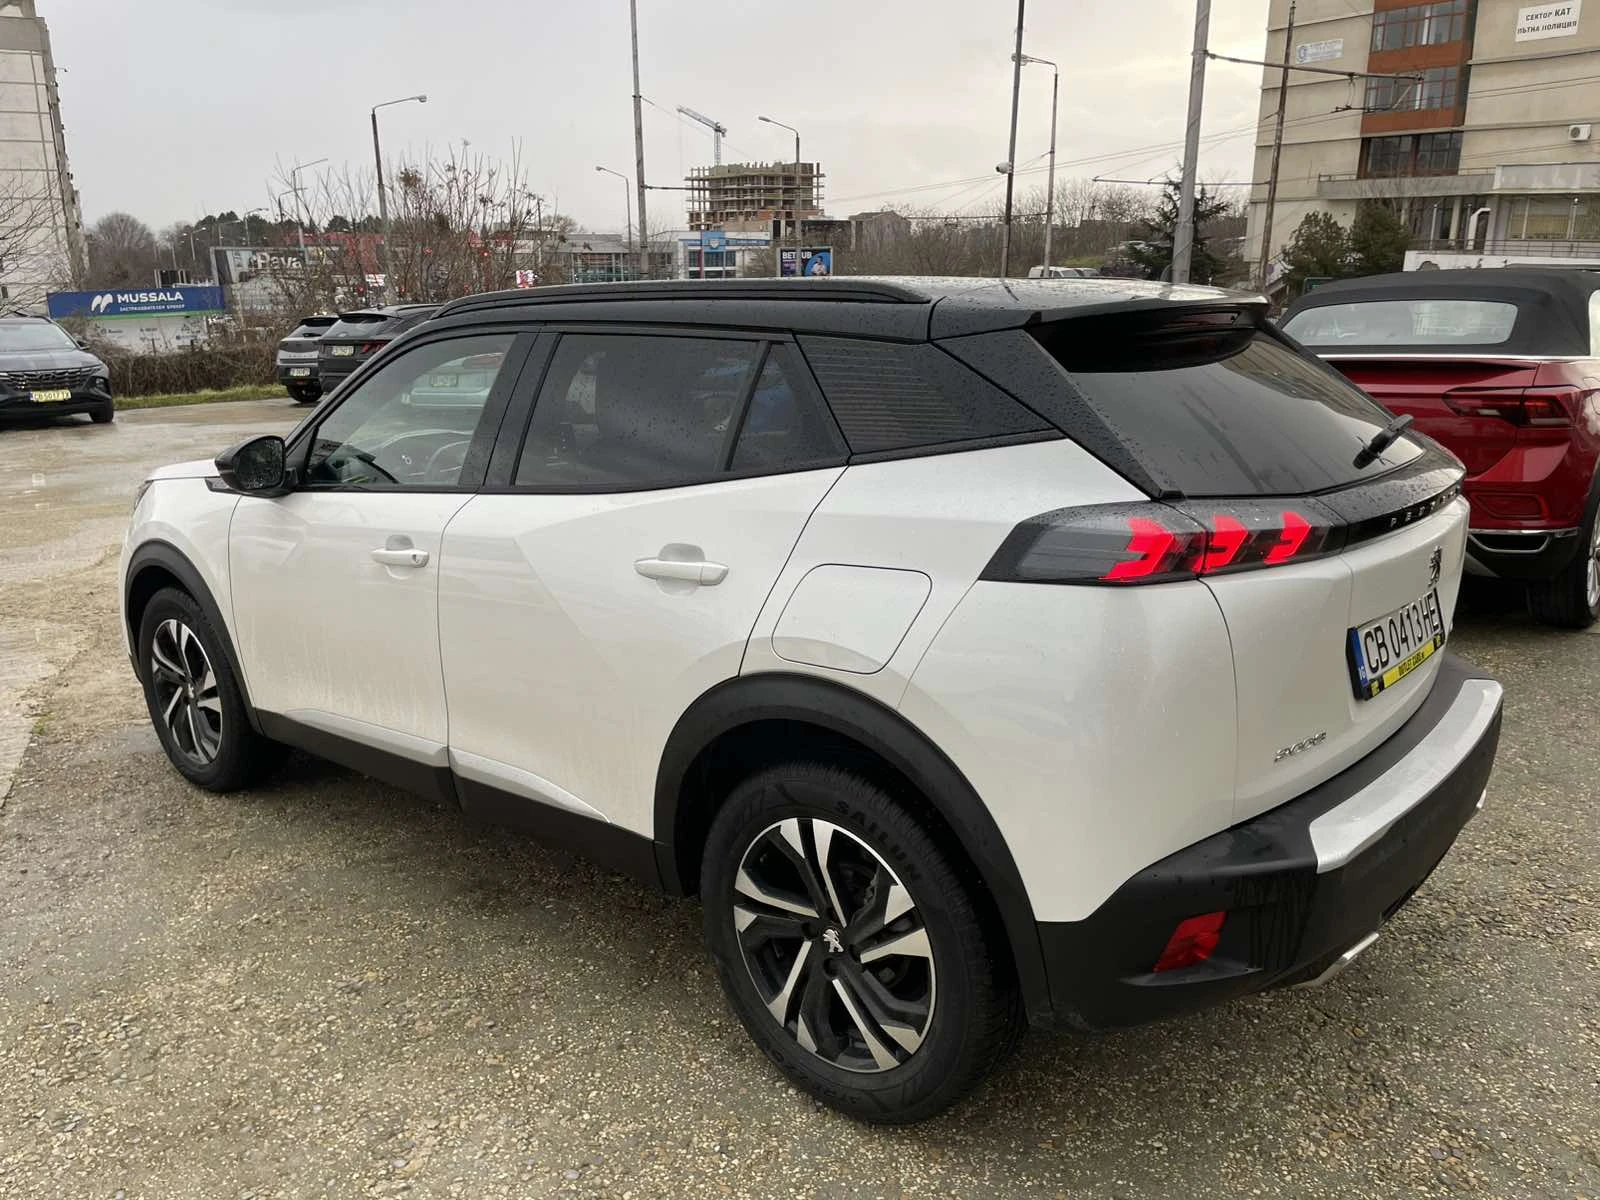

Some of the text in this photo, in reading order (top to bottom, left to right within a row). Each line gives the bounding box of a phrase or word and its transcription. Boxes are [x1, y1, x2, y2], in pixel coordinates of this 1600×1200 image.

[1525, 7, 1572, 21] СЕКТОР КАТ
[1541, 20, 1577, 31] ПОЛИЦИЯ
[782, 251, 813, 260] BETUB
[116, 291, 184, 304] MUSSALA
[833, 800, 922, 882] SAILUN
